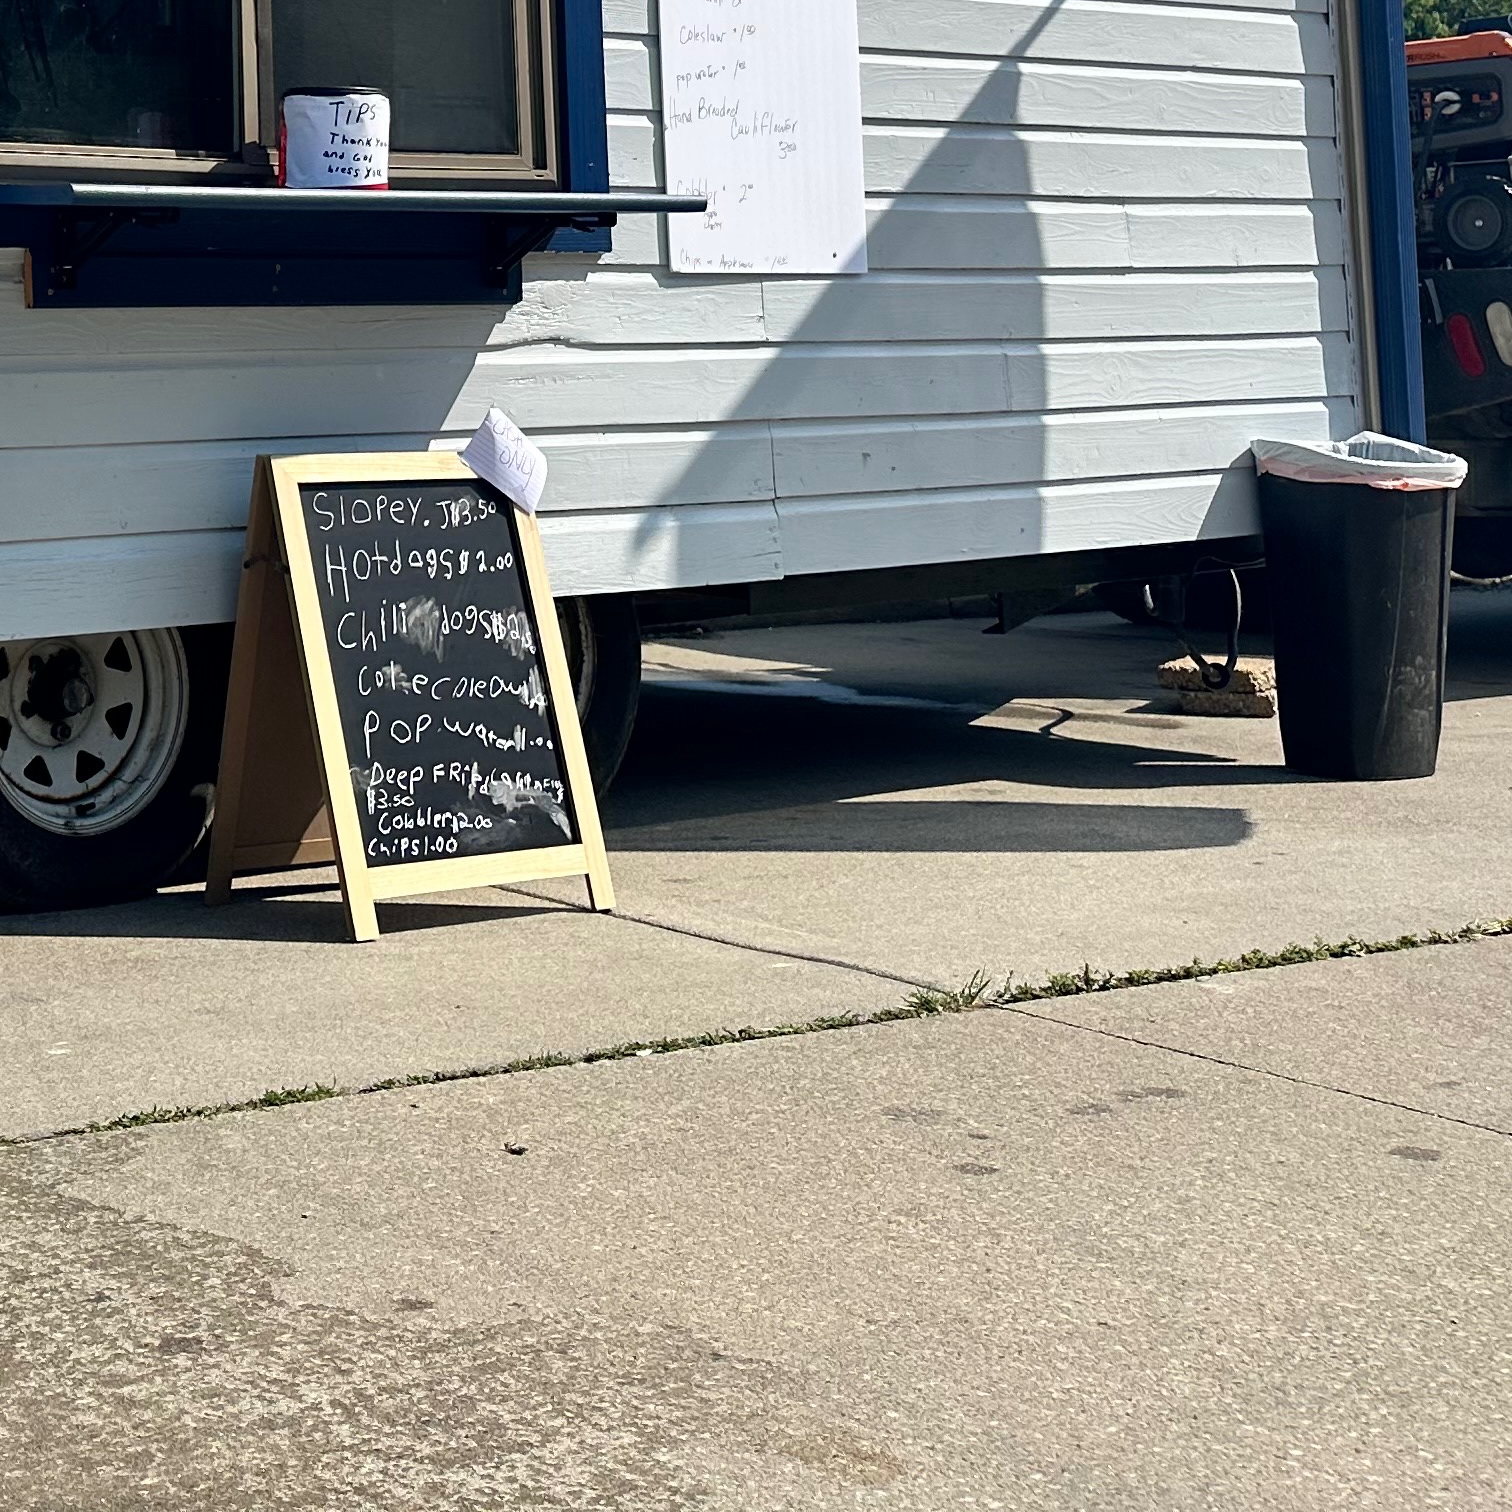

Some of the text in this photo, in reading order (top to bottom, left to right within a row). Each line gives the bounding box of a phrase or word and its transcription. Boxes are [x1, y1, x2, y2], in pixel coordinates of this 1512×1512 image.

[679, 23, 727, 45] Coleslaw
[330, 132, 372, 147] Thank
[323, 150, 345, 160] and
[498, 445, 537, 493] ONLY
